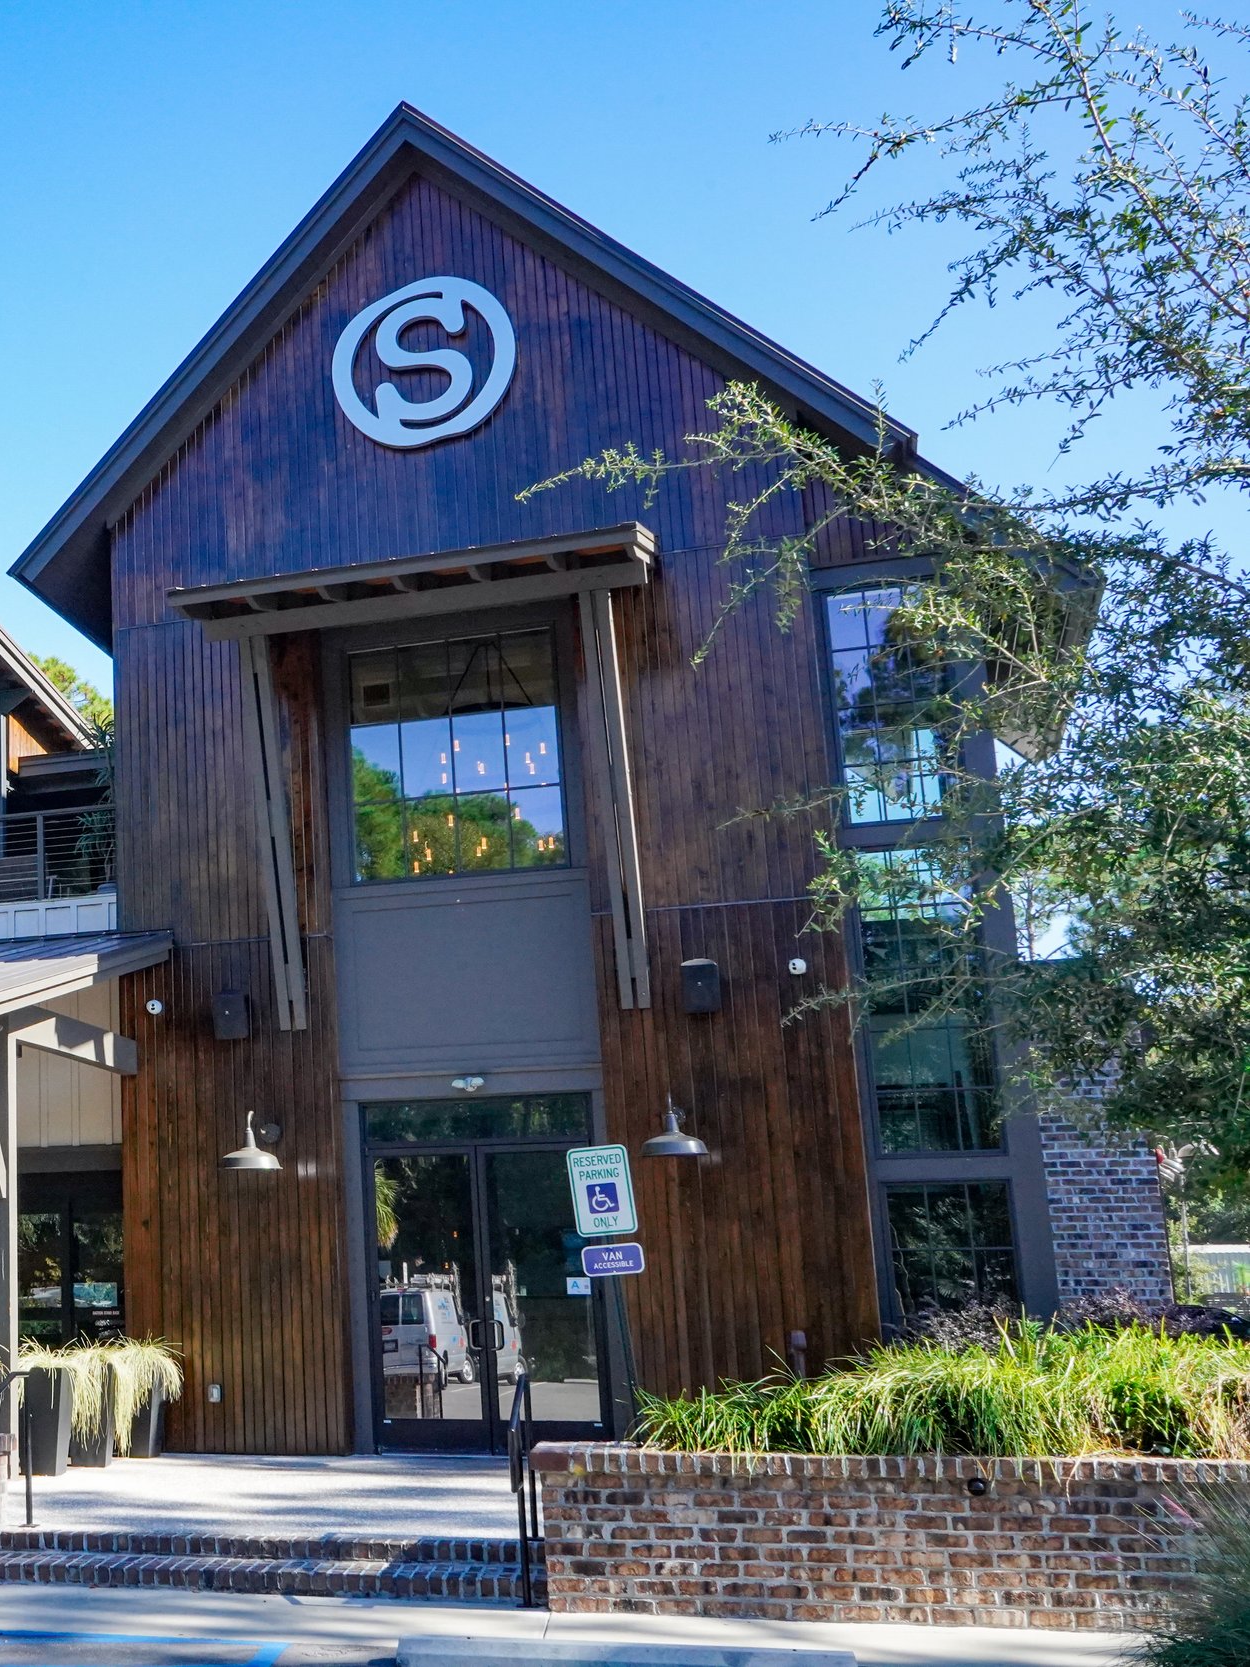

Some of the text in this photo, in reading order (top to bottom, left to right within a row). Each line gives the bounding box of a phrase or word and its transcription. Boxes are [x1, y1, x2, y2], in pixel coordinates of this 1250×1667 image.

[573, 1153, 622, 1168] RESERVED
[579, 1167, 620, 1181] PARKING
[593, 1216, 619, 1228] ONLY
[602, 1251, 623, 1260] VAN
[593, 1260, 634, 1270] ACCESSIBLE
[571, 1280, 580, 1290] A
